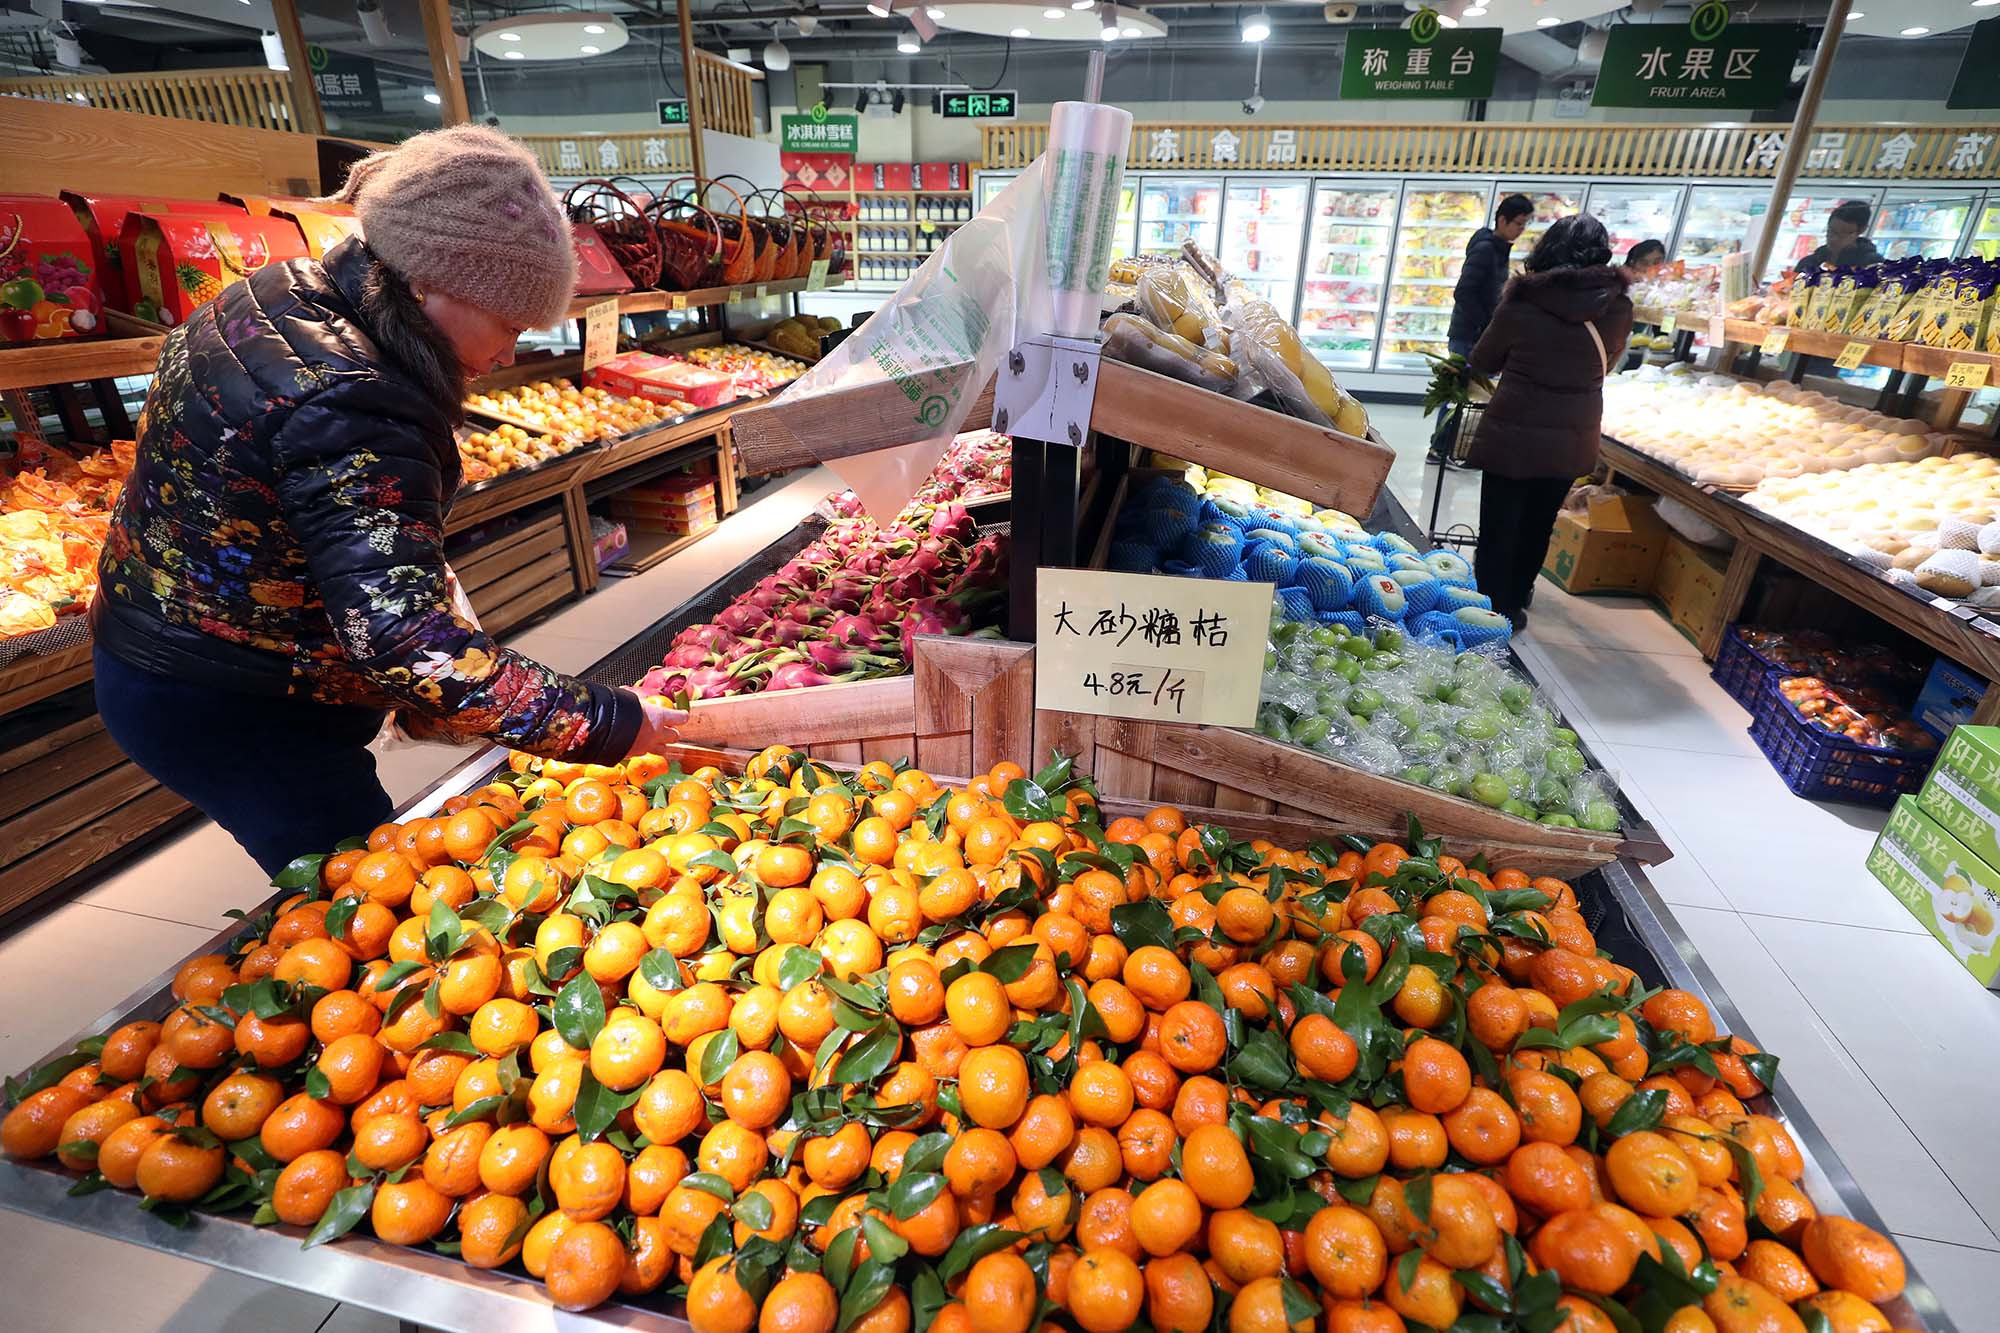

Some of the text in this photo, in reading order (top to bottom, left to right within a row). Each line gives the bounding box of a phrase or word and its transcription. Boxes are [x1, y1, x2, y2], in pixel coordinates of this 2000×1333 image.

[1361, 47, 1475, 76] 称重台
[1636, 46, 1760, 80] 水果区
[1375, 80, 1455, 91] WEIGHING TABLE
[1650, 86, 1727, 98] FRUIT AREA
[1150, 128, 1297, 163] 冻食品
[1053, 601, 1228, 648] 大砂糖桔
[1889, 804, 1949, 860] 阳光
